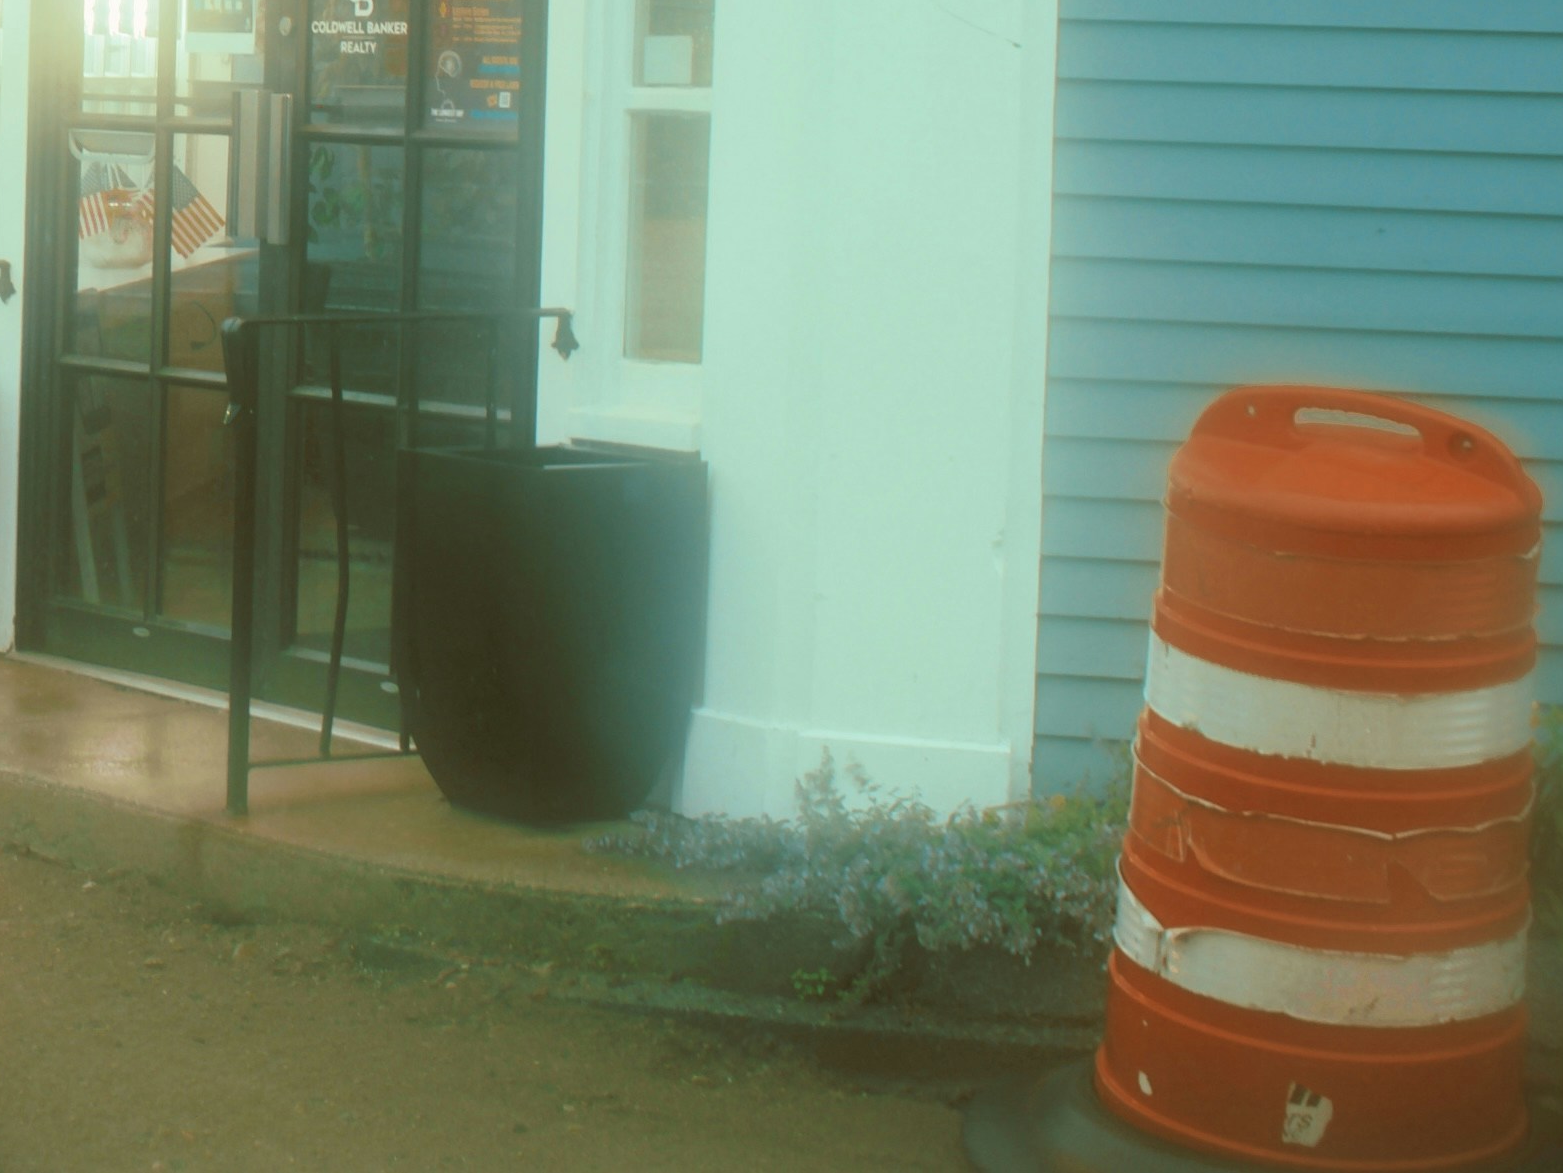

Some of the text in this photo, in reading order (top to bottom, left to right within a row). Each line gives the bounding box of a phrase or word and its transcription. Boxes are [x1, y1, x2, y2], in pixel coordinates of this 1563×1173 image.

[311, 21, 408, 35] COLDWELL BANKER
[340, 41, 377, 54] REALTY
